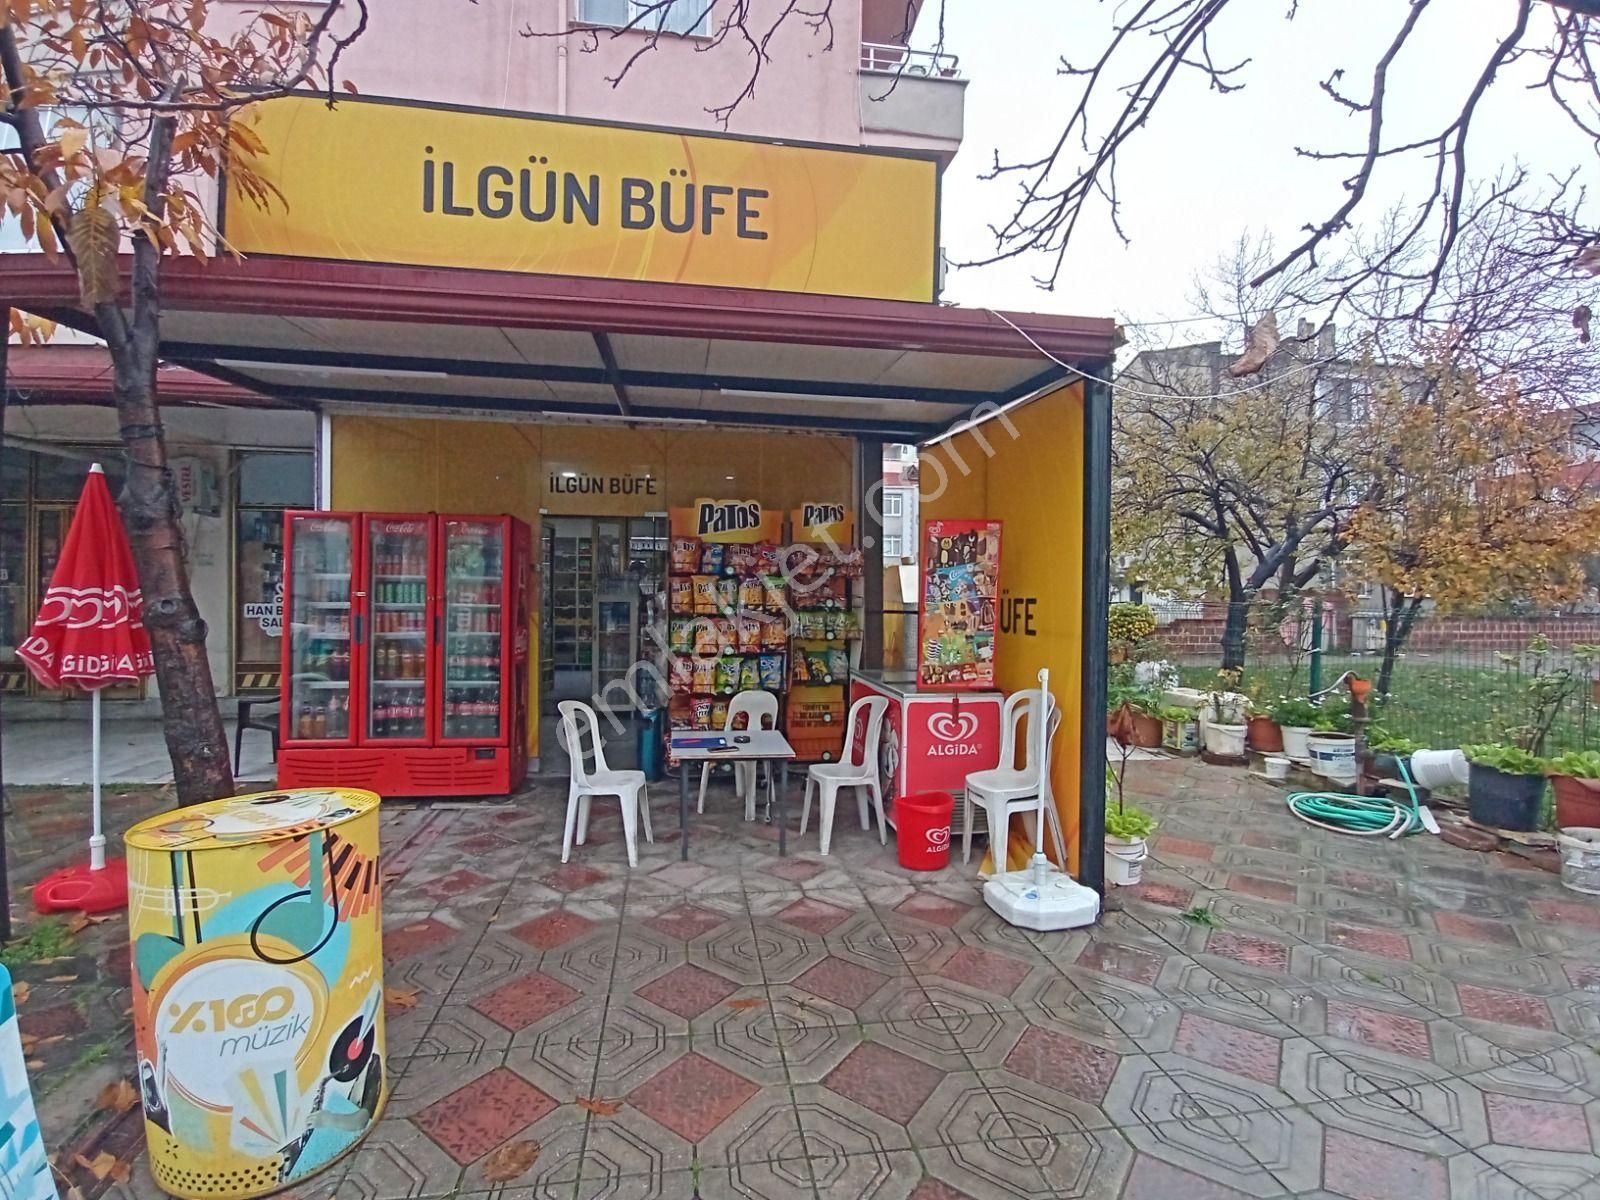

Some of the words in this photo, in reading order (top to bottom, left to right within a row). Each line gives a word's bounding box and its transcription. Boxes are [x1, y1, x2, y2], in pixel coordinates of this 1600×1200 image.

[423, 145, 600, 226] İLGÜN
[621, 168, 769, 240] BÜFE
[549, 472, 604, 494] İLGÜN
[609, 473, 657, 495] BÜFE
[246, 606, 273, 615] HAN
[1001, 589, 1037, 636] ÜFE
[219, 1013, 311, 1057] müzik
